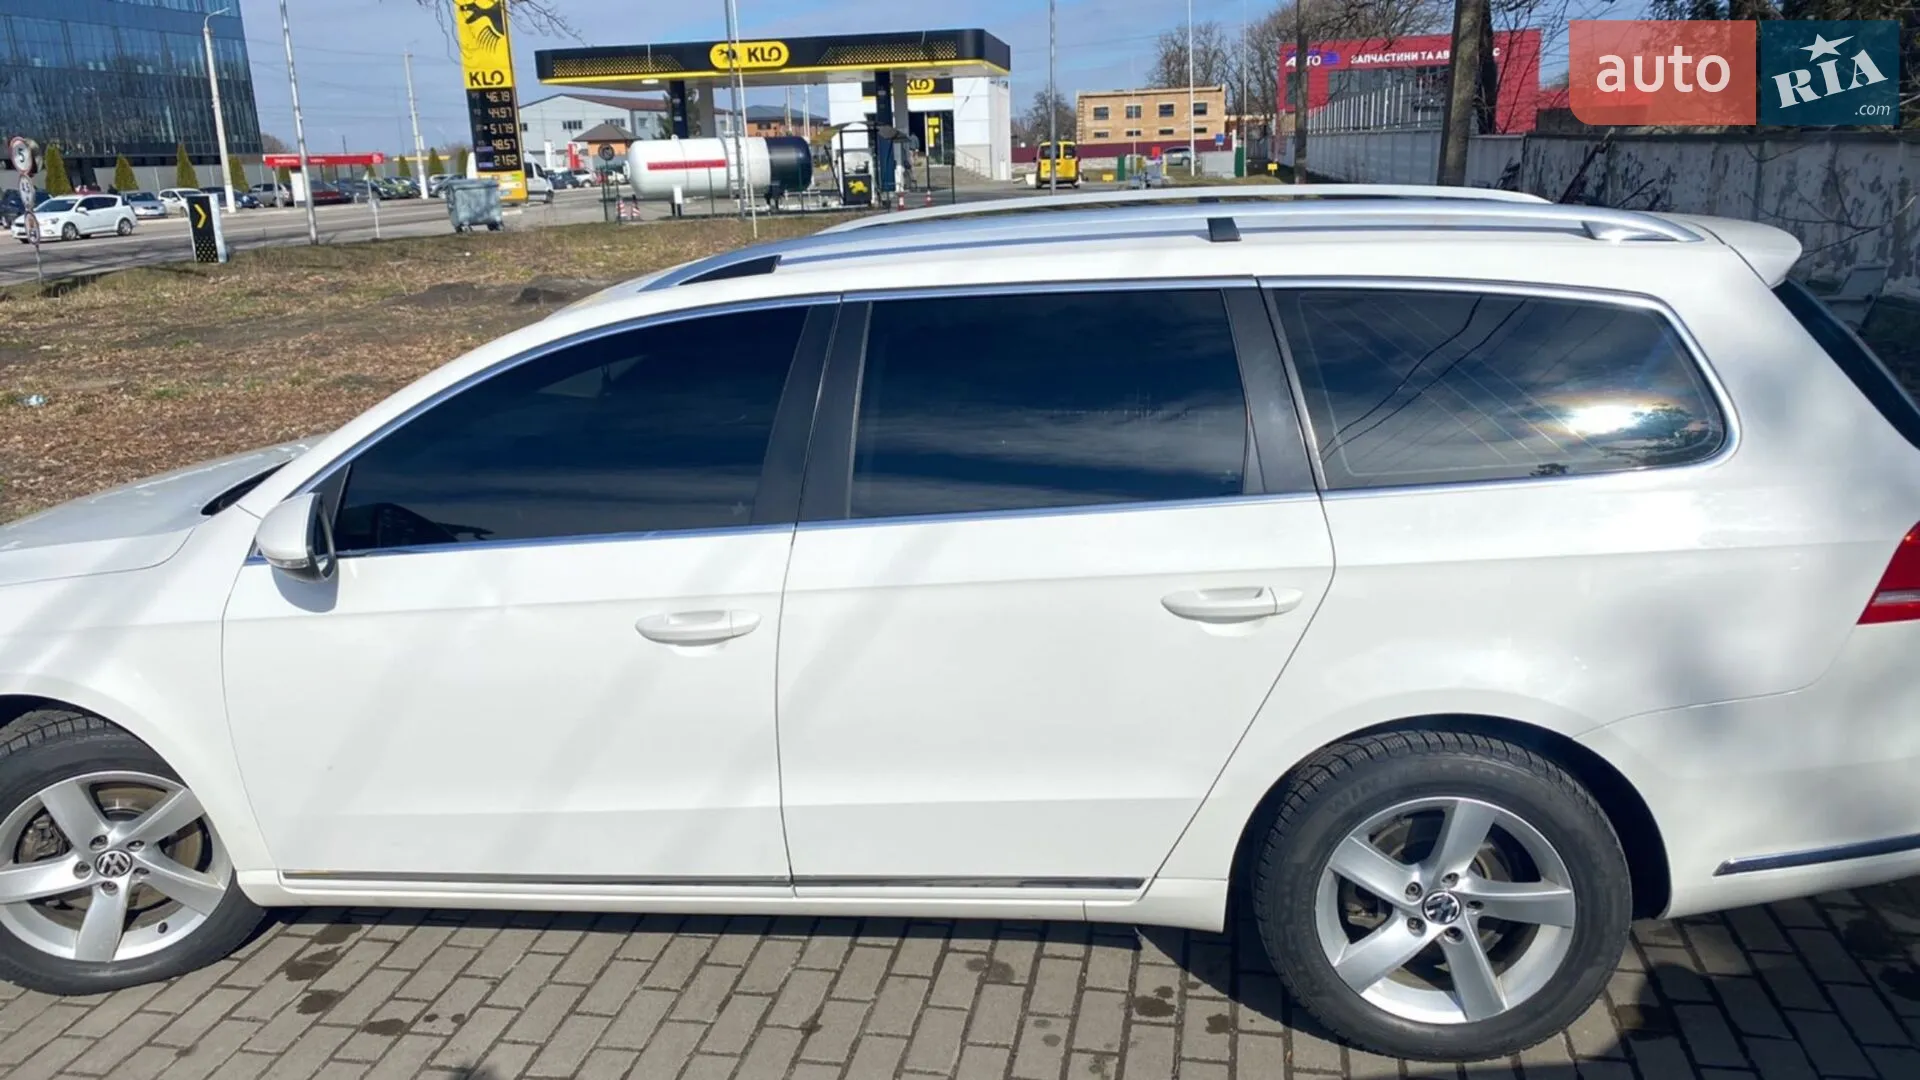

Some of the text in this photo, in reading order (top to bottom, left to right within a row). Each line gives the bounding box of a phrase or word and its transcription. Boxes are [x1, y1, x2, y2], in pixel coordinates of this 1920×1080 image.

[748, 46, 782, 63] KLO
[1285, 55, 1322, 67] АТО
[1350, 51, 1418, 64] ЗАПЧАСТИНИ
[1420, 51, 1433, 60] ТА
[469, 70, 505, 87] KLO
[17, 147, 25, 163] 5
